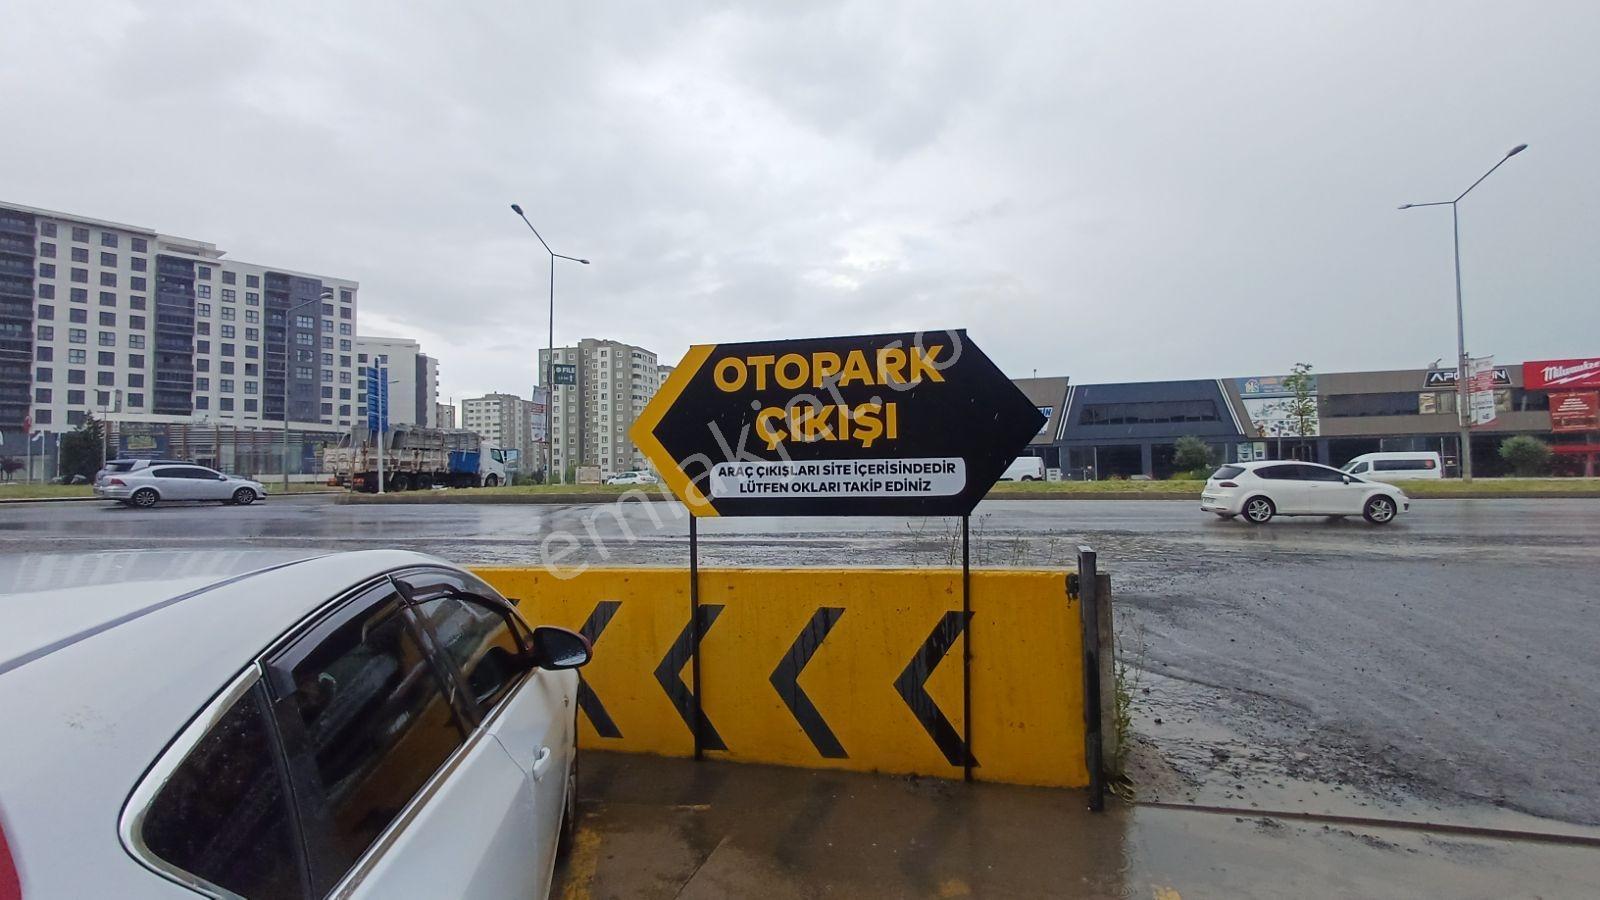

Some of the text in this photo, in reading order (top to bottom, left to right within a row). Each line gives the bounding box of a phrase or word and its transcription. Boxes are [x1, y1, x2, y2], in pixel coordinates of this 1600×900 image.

[713, 345, 945, 392] OTOPARK
[755, 402, 898, 450] ÇIKIŞI
[718, 459, 956, 479] ARAÇ ÇIKIŞLARI SİTE İÇERİSİNDEDİR
[739, 477, 932, 493] LÜTFEN OKLARI TAKİP EDİNİZ
